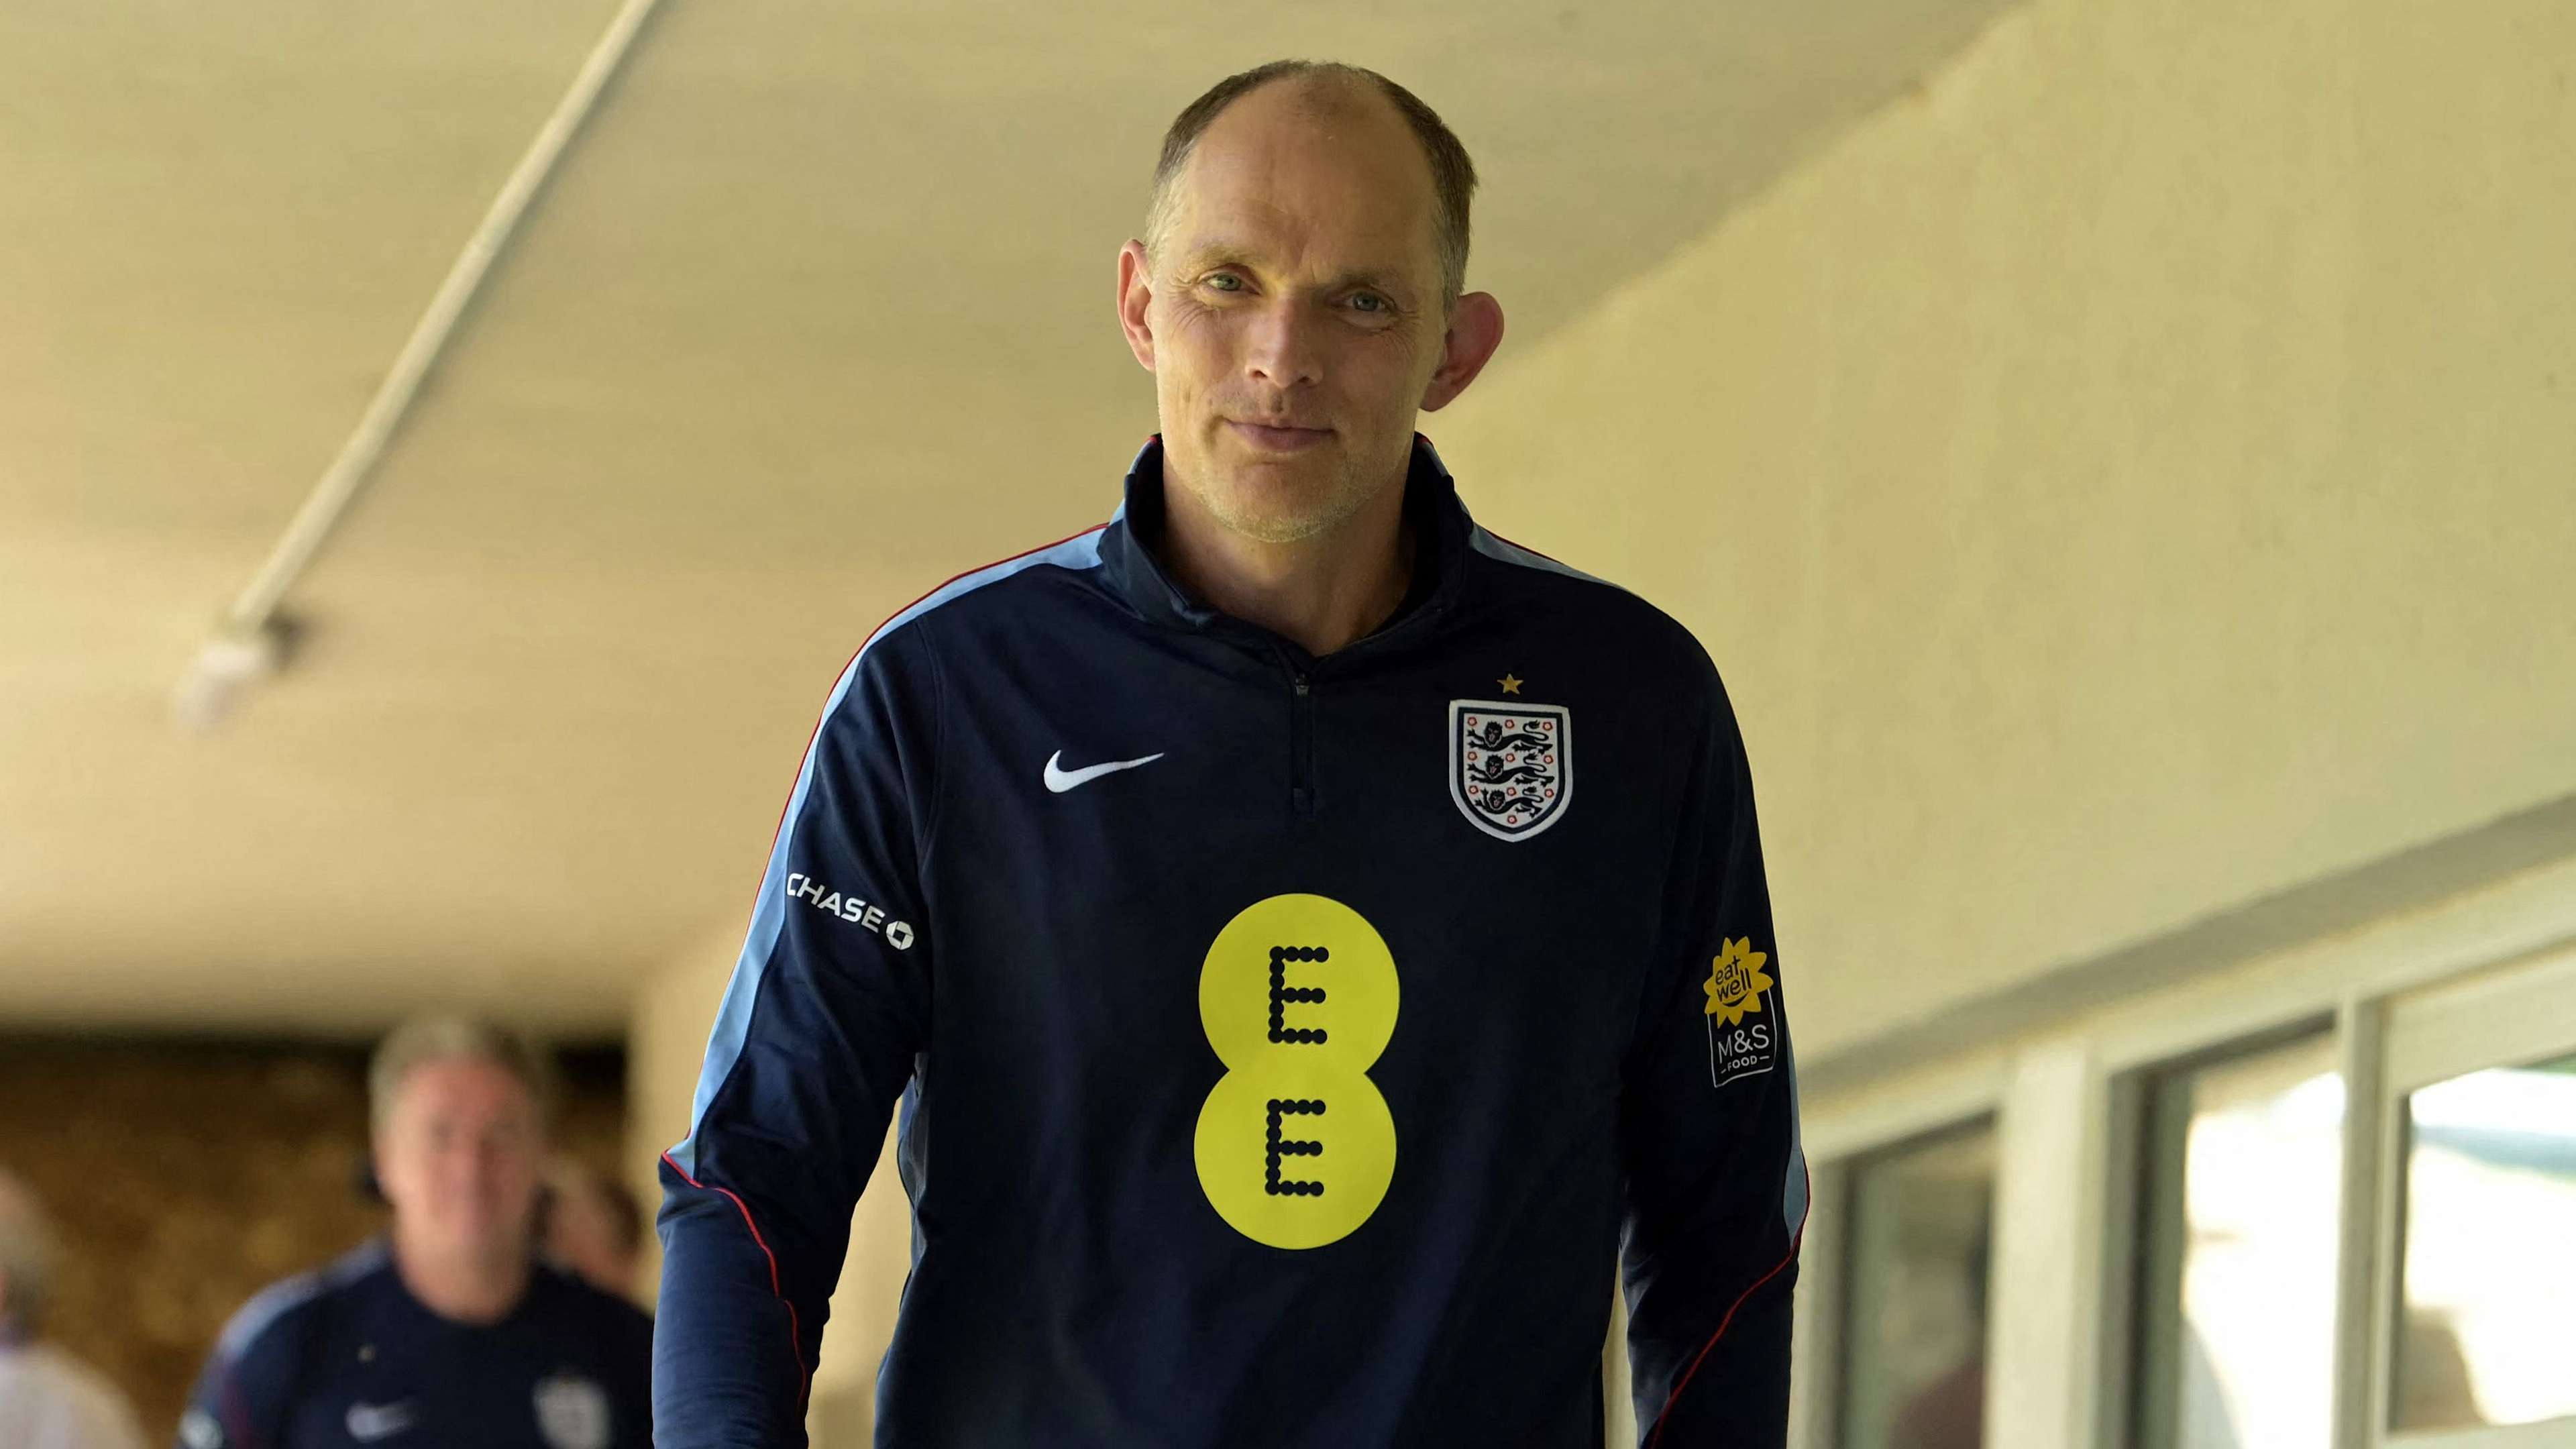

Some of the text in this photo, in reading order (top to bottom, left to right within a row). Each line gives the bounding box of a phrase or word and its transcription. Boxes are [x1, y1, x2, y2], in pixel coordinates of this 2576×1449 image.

[787, 872, 885, 934] CHASE
[1715, 955, 1741, 985] eat
[1717, 967, 1752, 1002] well
[1717, 1024, 1770, 1064] M&S
[1727, 1055, 1758, 1072] FOOD
